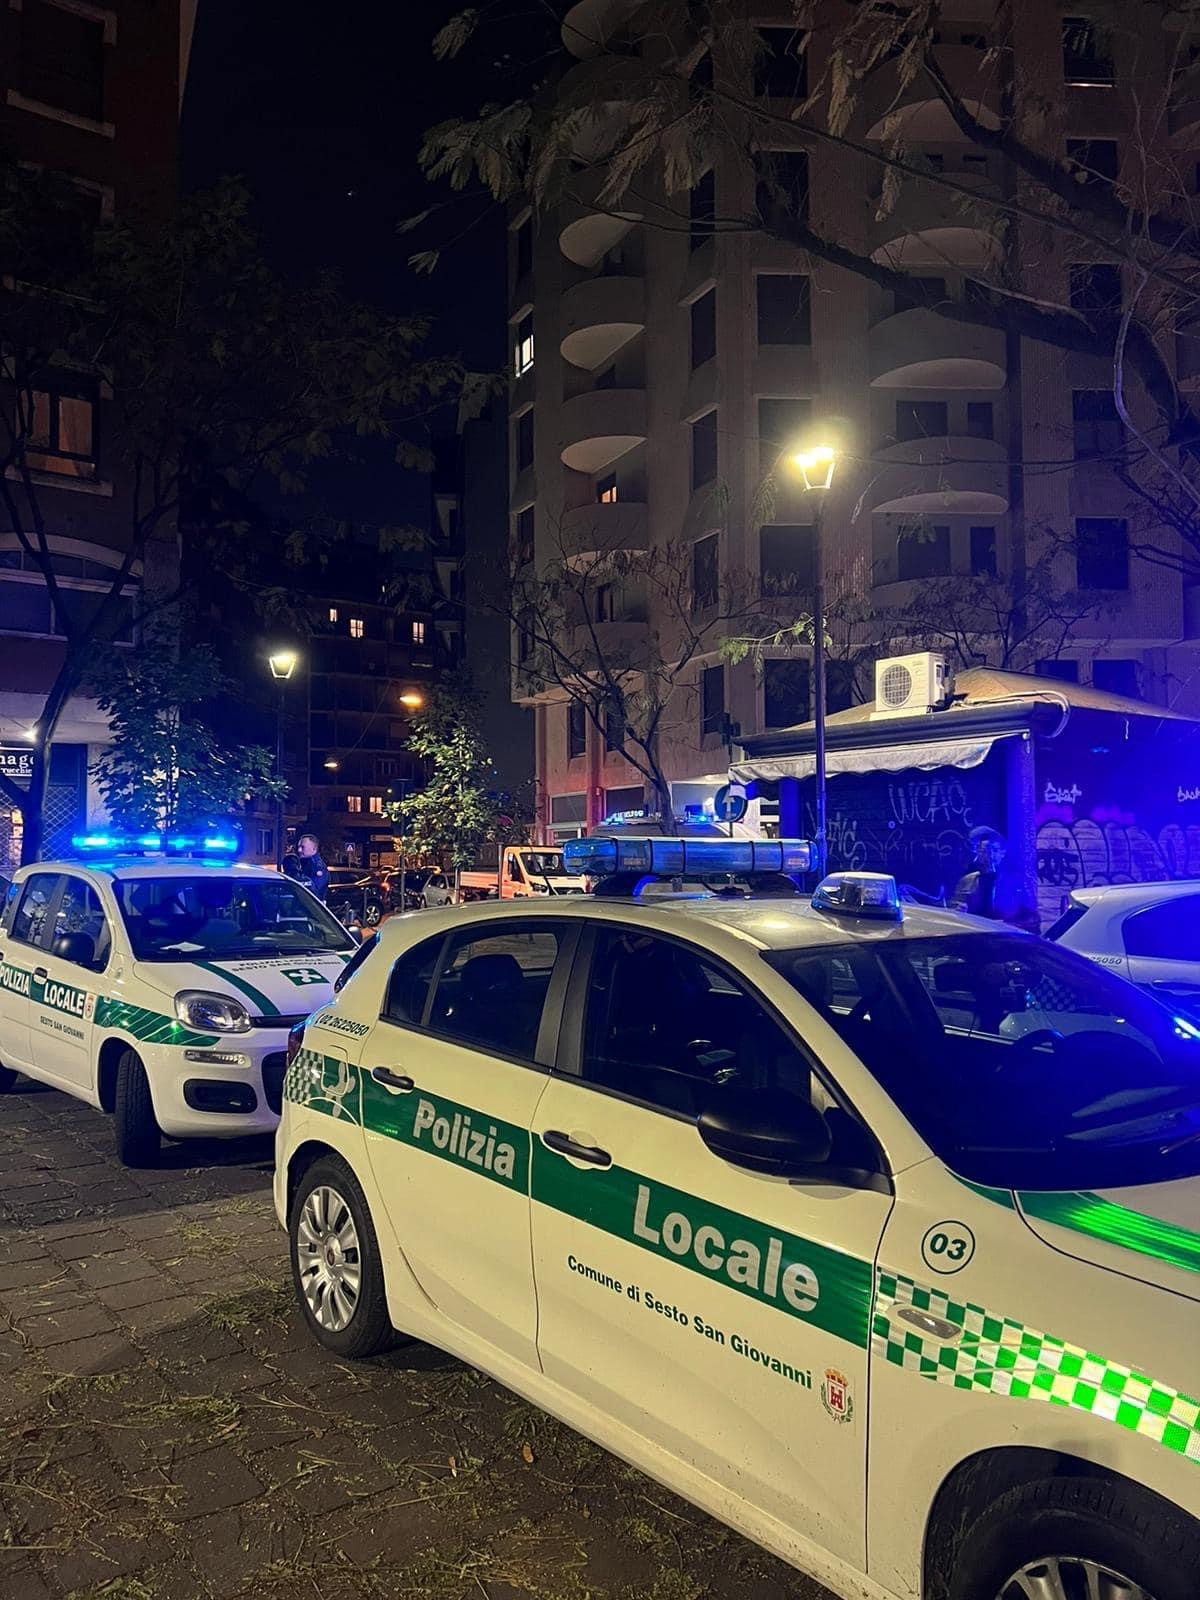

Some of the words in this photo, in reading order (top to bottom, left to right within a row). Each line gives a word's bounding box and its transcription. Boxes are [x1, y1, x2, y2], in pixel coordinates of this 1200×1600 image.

[0, 965, 30, 995] POLIZIA
[44, 982, 85, 1015] LOCALE
[413, 1098, 516, 1180] Polizia
[633, 1184, 820, 1313] Locale
[930, 1233, 967, 1260] 03
[567, 1254, 623, 1294] Comune
[627, 1284, 640, 1303] di
[644, 1291, 689, 1326] Sesto
[693, 1315, 725, 1345] San
[730, 1333, 813, 1390] Giovanni
